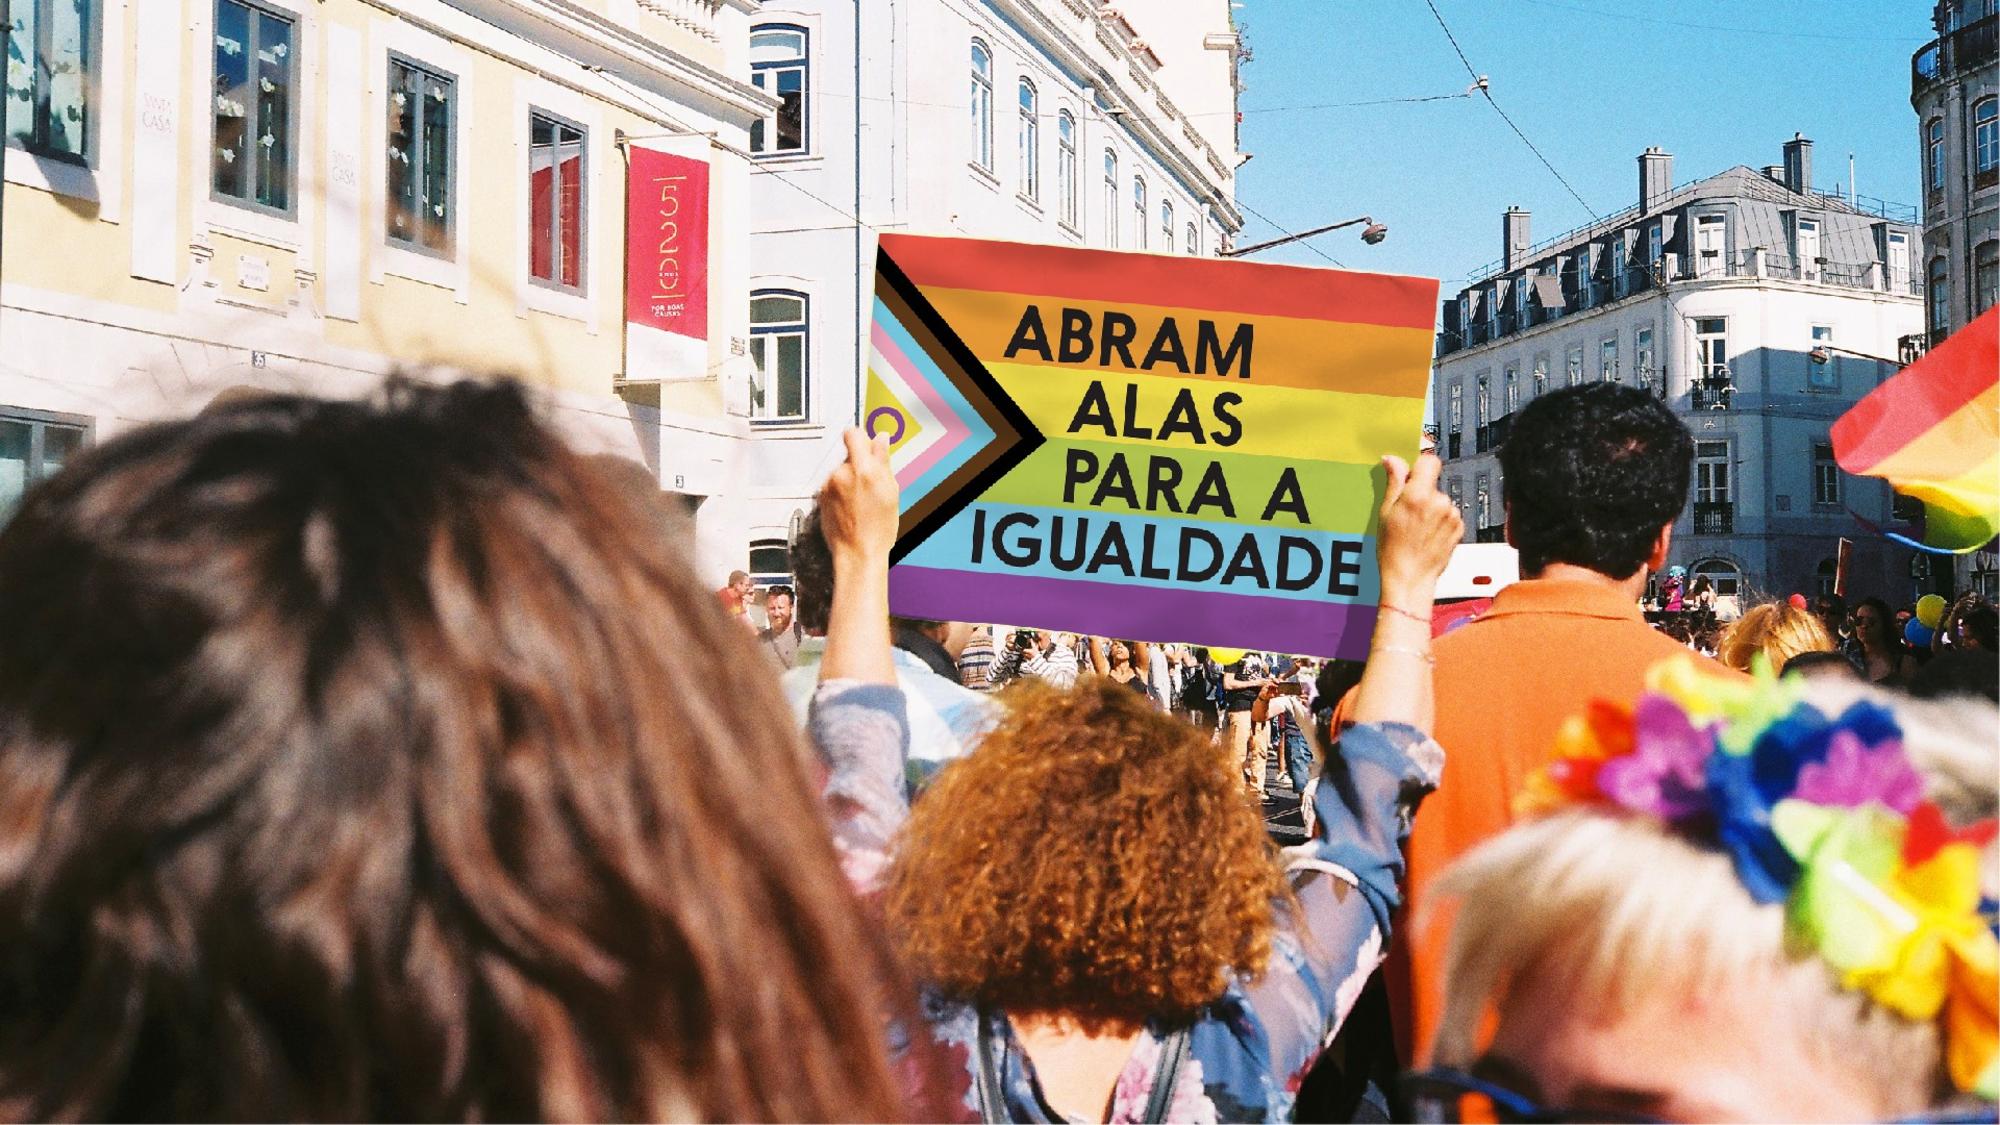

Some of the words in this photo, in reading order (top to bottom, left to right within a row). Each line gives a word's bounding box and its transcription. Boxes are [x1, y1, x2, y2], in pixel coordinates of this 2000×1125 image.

[659, 184, 679, 290] 520
[1003, 304, 1255, 379] ABRAM
[1066, 380, 1243, 447] ALAS
[1063, 448, 1237, 518] PARA
[1260, 467, 1312, 524] A
[970, 509, 1364, 597] IGUALDADE
